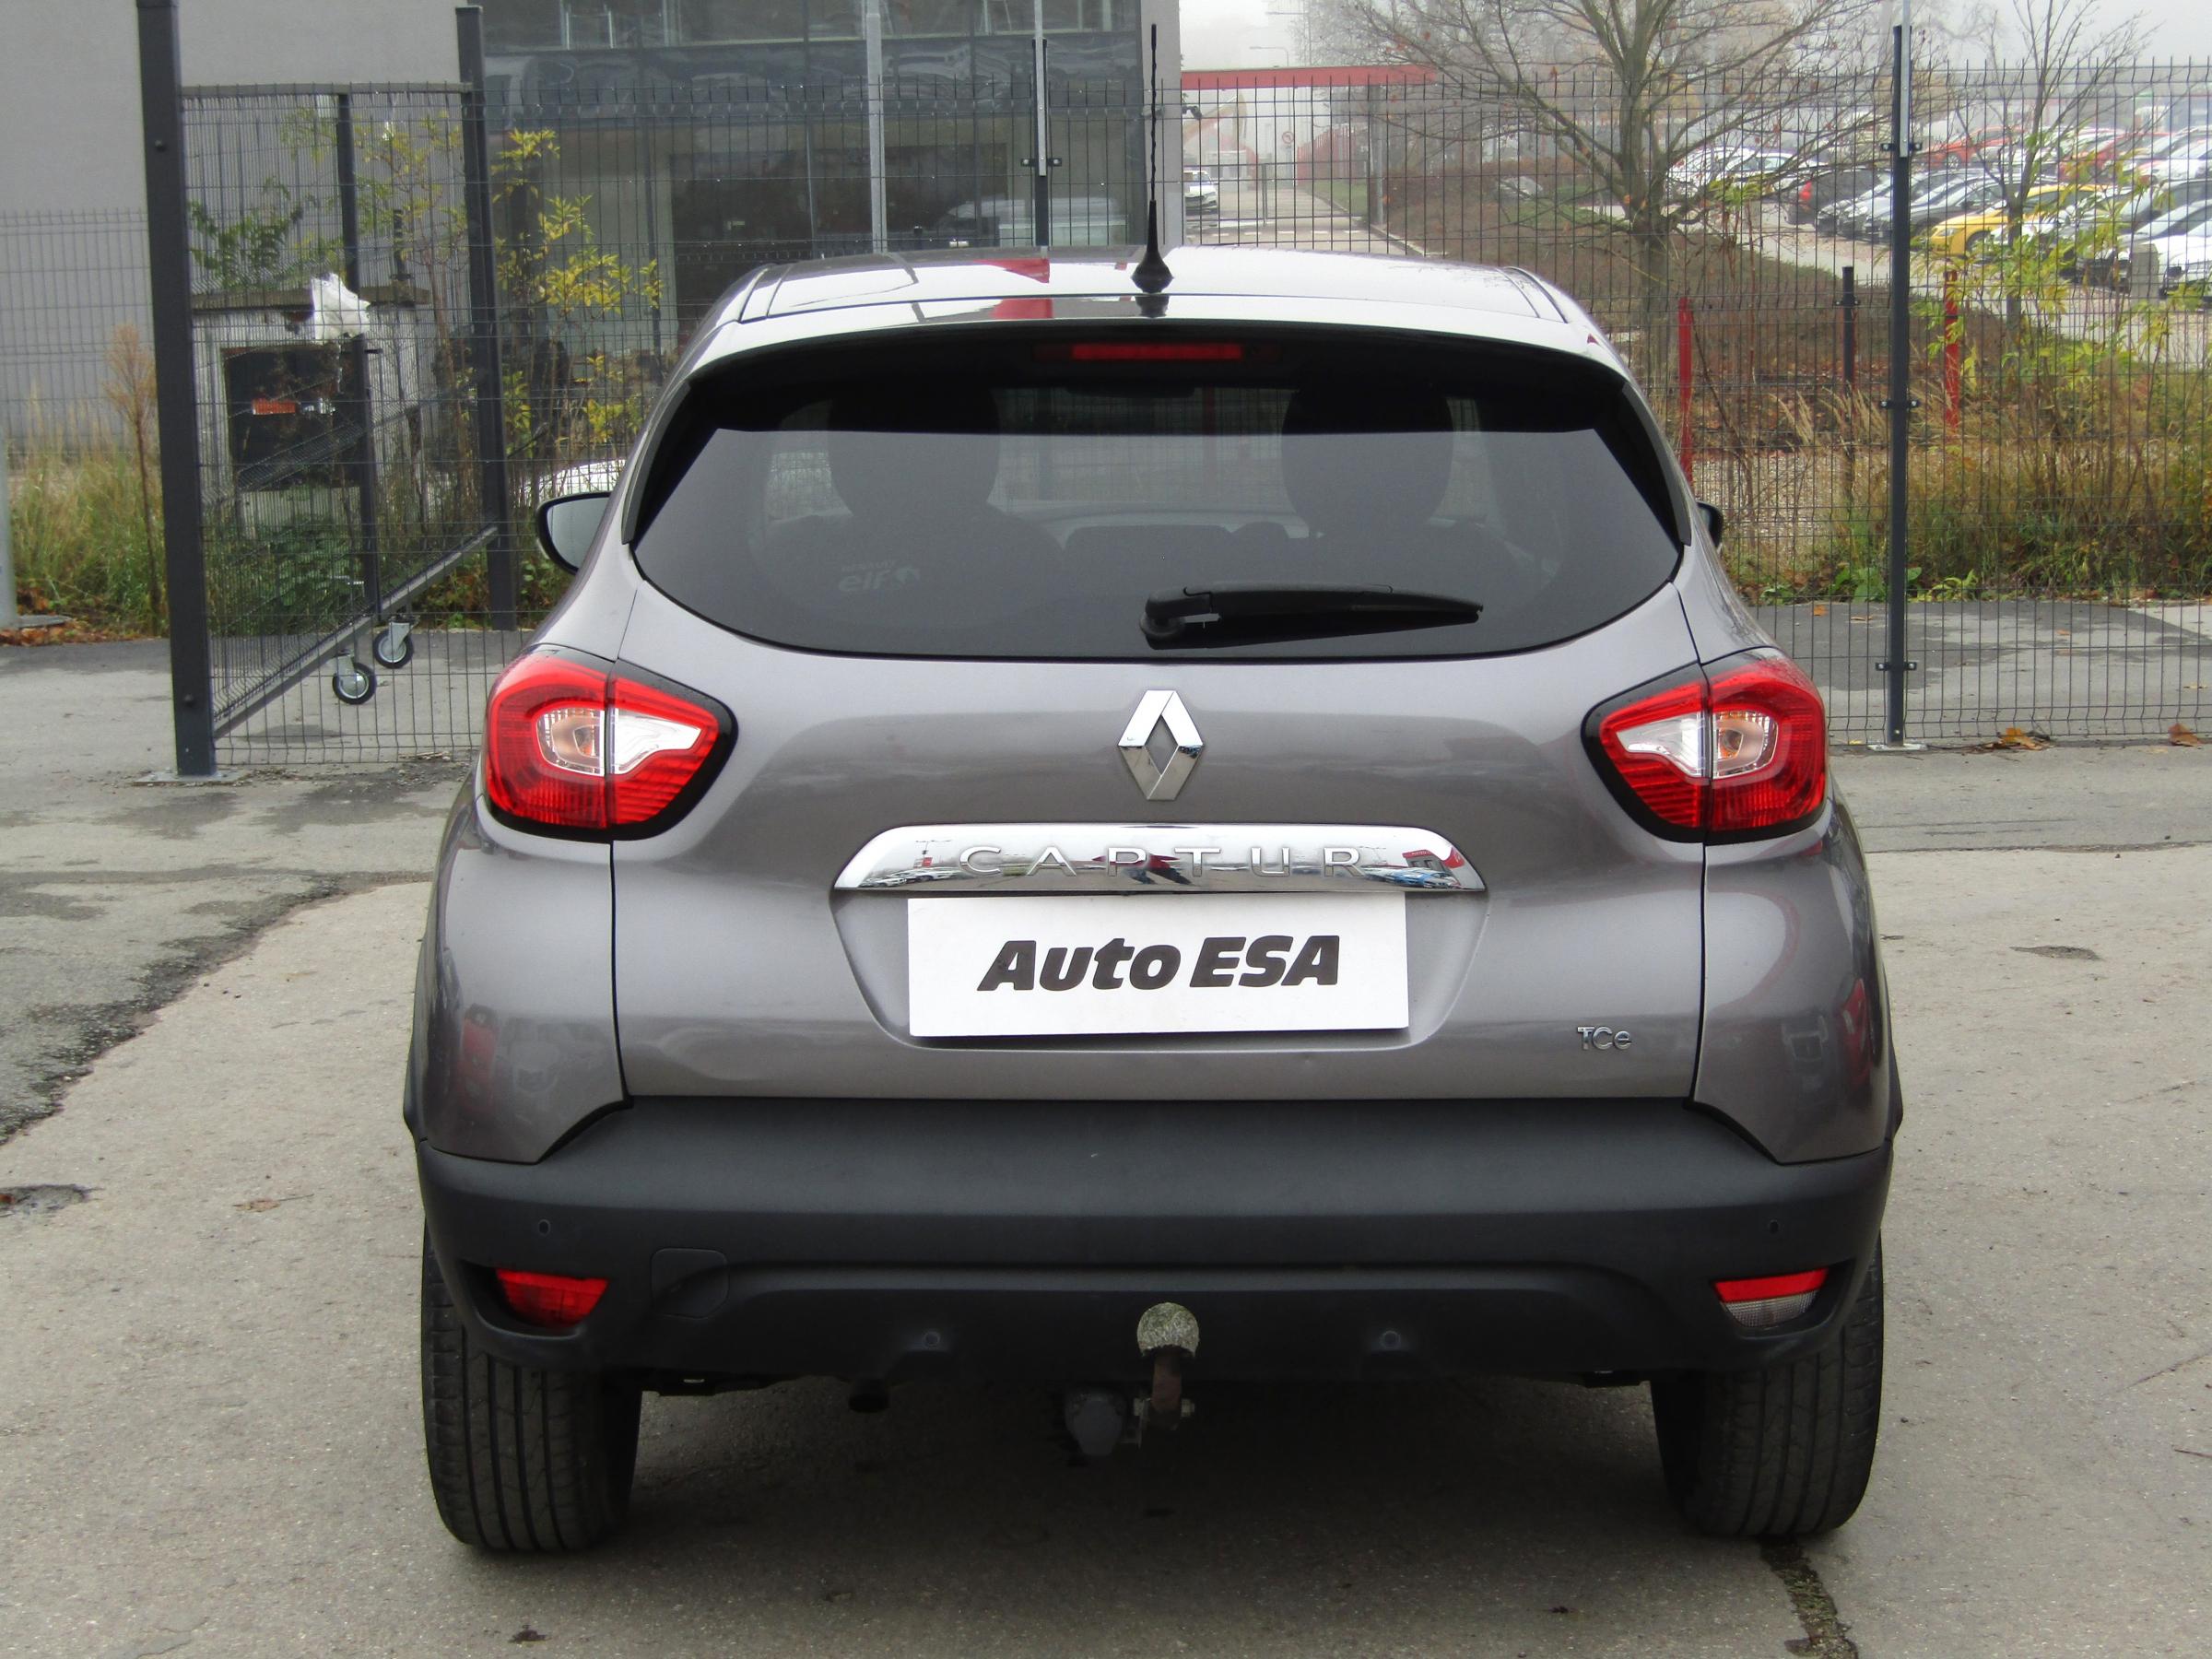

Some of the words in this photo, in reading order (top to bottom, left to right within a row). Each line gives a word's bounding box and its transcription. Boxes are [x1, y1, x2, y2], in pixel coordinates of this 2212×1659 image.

[838, 568, 890, 592] elf
[959, 846, 1364, 877] CAPTUR
[977, 937, 1181, 992] Auto
[1189, 935, 1340, 988] ESA
[1577, 1026, 1631, 1050] TCe
